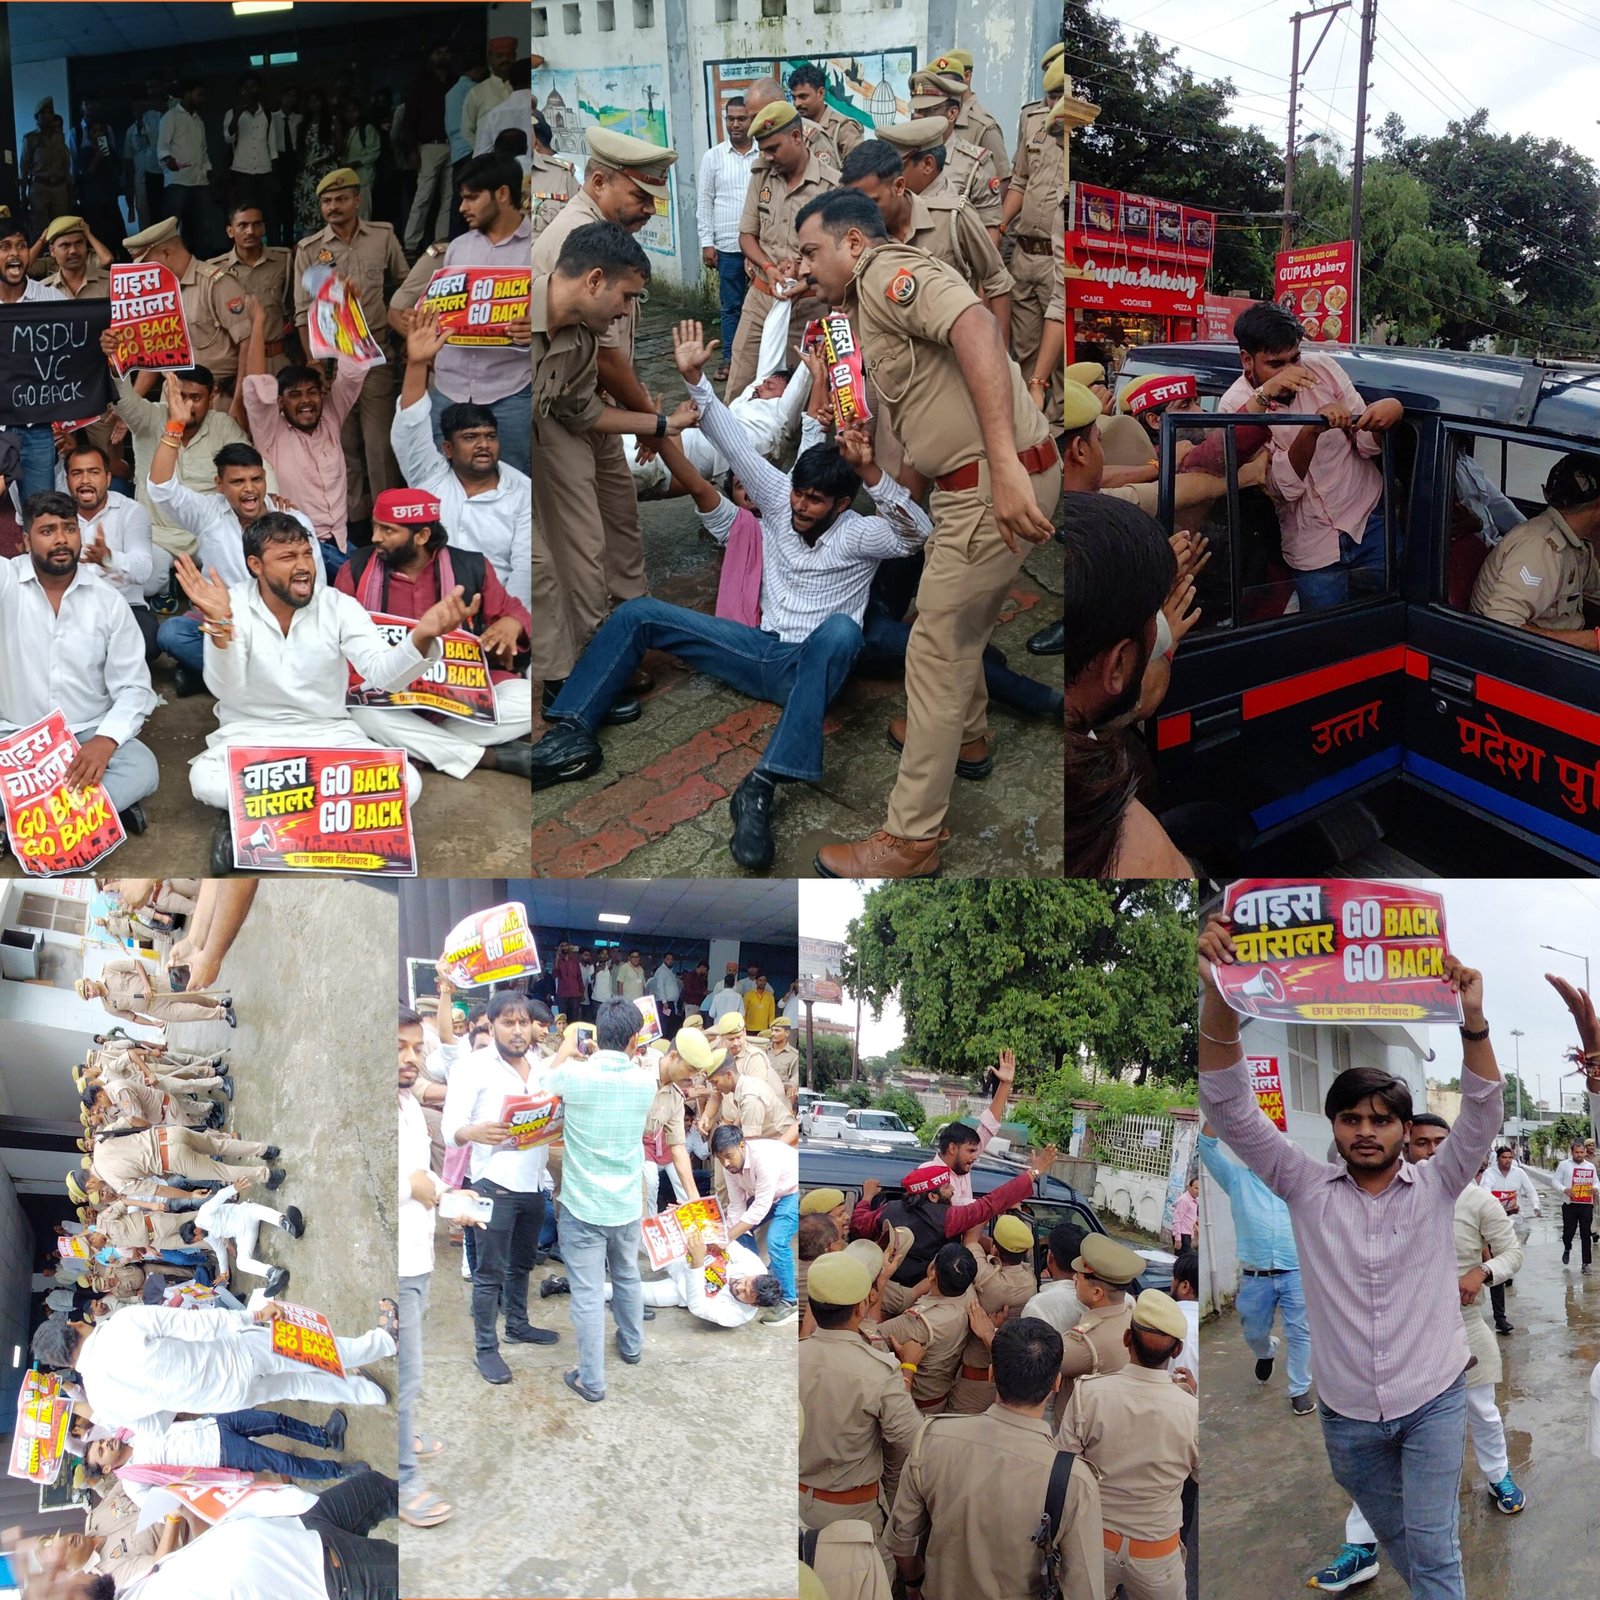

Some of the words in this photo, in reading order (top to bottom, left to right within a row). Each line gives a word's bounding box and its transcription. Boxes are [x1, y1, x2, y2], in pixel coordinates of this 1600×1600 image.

[113, 268, 160, 297] वाइस
[427, 273, 467, 297] वाइस
[1138, 266, 1198, 299] Bakery
[1279, 263, 1311, 281] GUPTA
[1312, 261, 1346, 277] Bakery
[471, 278, 494, 301] GO
[493, 278, 530, 299] BACK
[1083, 295, 1104, 304] CAKE
[1122, 299, 1152, 308] COOKIES
[1174, 303, 1192, 312] PIZZA
[139, 315, 182, 338] BACK
[468, 302, 491, 325] GO
[490, 302, 528, 323] BACK
[12, 321, 88, 353] MSDU
[118, 341, 139, 362] GO
[144, 332, 186, 354] BACK
[34, 355, 71, 381] VC
[832, 363, 853, 387] GO
[838, 386, 860, 418] BAC
[1150, 381, 1188, 401] सभा
[391, 504, 425, 518] छात्र
[445, 640, 481, 661] BACK
[447, 665, 487, 687] BACK
[1311, 700, 1383, 754] उत्तर
[1456, 712, 1546, 783] प्रदेश
[243, 757, 307, 792] वाइस
[319, 764, 351, 797] GO
[353, 765, 401, 794] BACK
[244, 786, 316, 818] चांसलर
[318, 800, 352, 834] GO
[353, 800, 403, 831] BACK
[17, 806, 46, 839] GO
[23, 836, 56, 857] GO
[58, 795, 112, 852] BACK
[1233, 886, 1321, 927] वाइस
[1341, 900, 1381, 939] GO
[1384, 906, 1439, 936] BACK
[1231, 923, 1335, 964] चांसलर
[1343, 944, 1384, 982] GO
[1387, 947, 1443, 979] BACK
[1311, 1006, 1334, 1017] छात्र
[1337, 1007, 1366, 1017] एकता
[1263, 1106, 1285, 1120] ACK
[909, 1181, 929, 1192] छात्र
[275, 1321, 297, 1336] GO
[300, 1327, 335, 1351] BACK
[275, 1333, 298, 1350] GO
[302, 1340, 340, 1365] BACK
